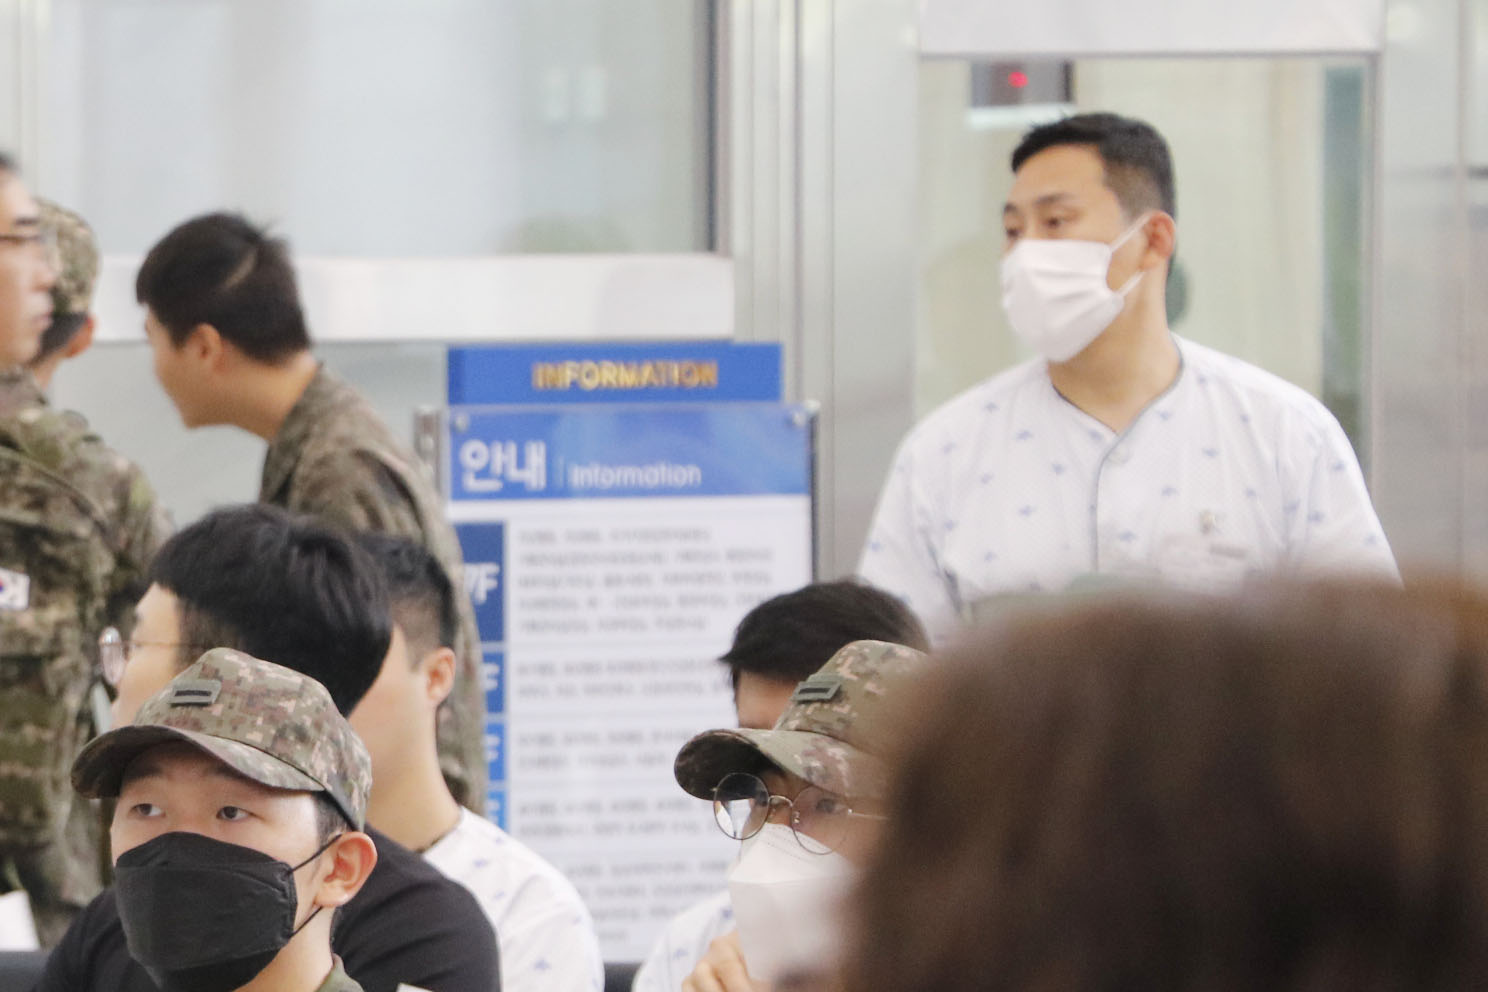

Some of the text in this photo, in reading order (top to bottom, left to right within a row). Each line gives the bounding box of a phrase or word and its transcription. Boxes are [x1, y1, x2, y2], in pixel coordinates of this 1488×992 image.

[532, 361, 718, 389] INFORMATION
[460, 439, 702, 491] 안내 Information
